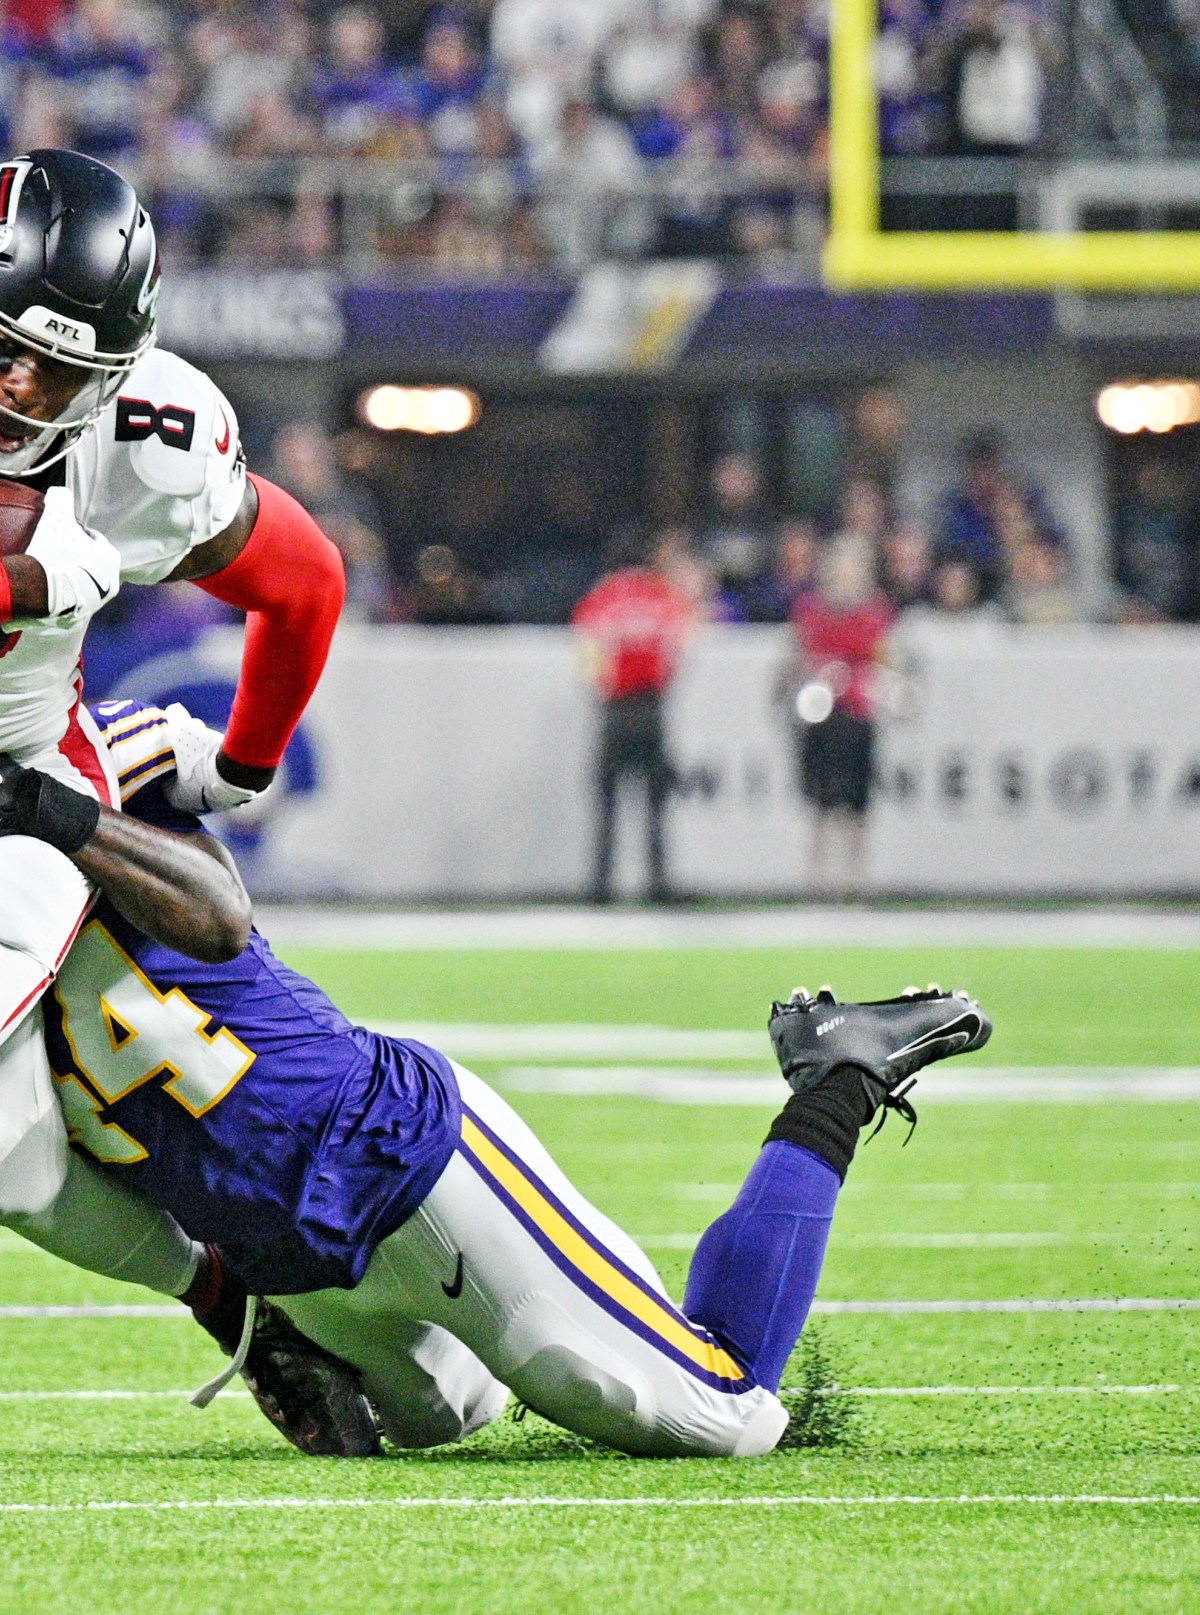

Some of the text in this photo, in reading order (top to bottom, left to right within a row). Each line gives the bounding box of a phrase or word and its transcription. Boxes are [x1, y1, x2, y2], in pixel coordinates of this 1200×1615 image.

[44, 318, 80, 340] ATL
[115, 396, 195, 452] 8
[816, 1015, 846, 1036] VAPOR
